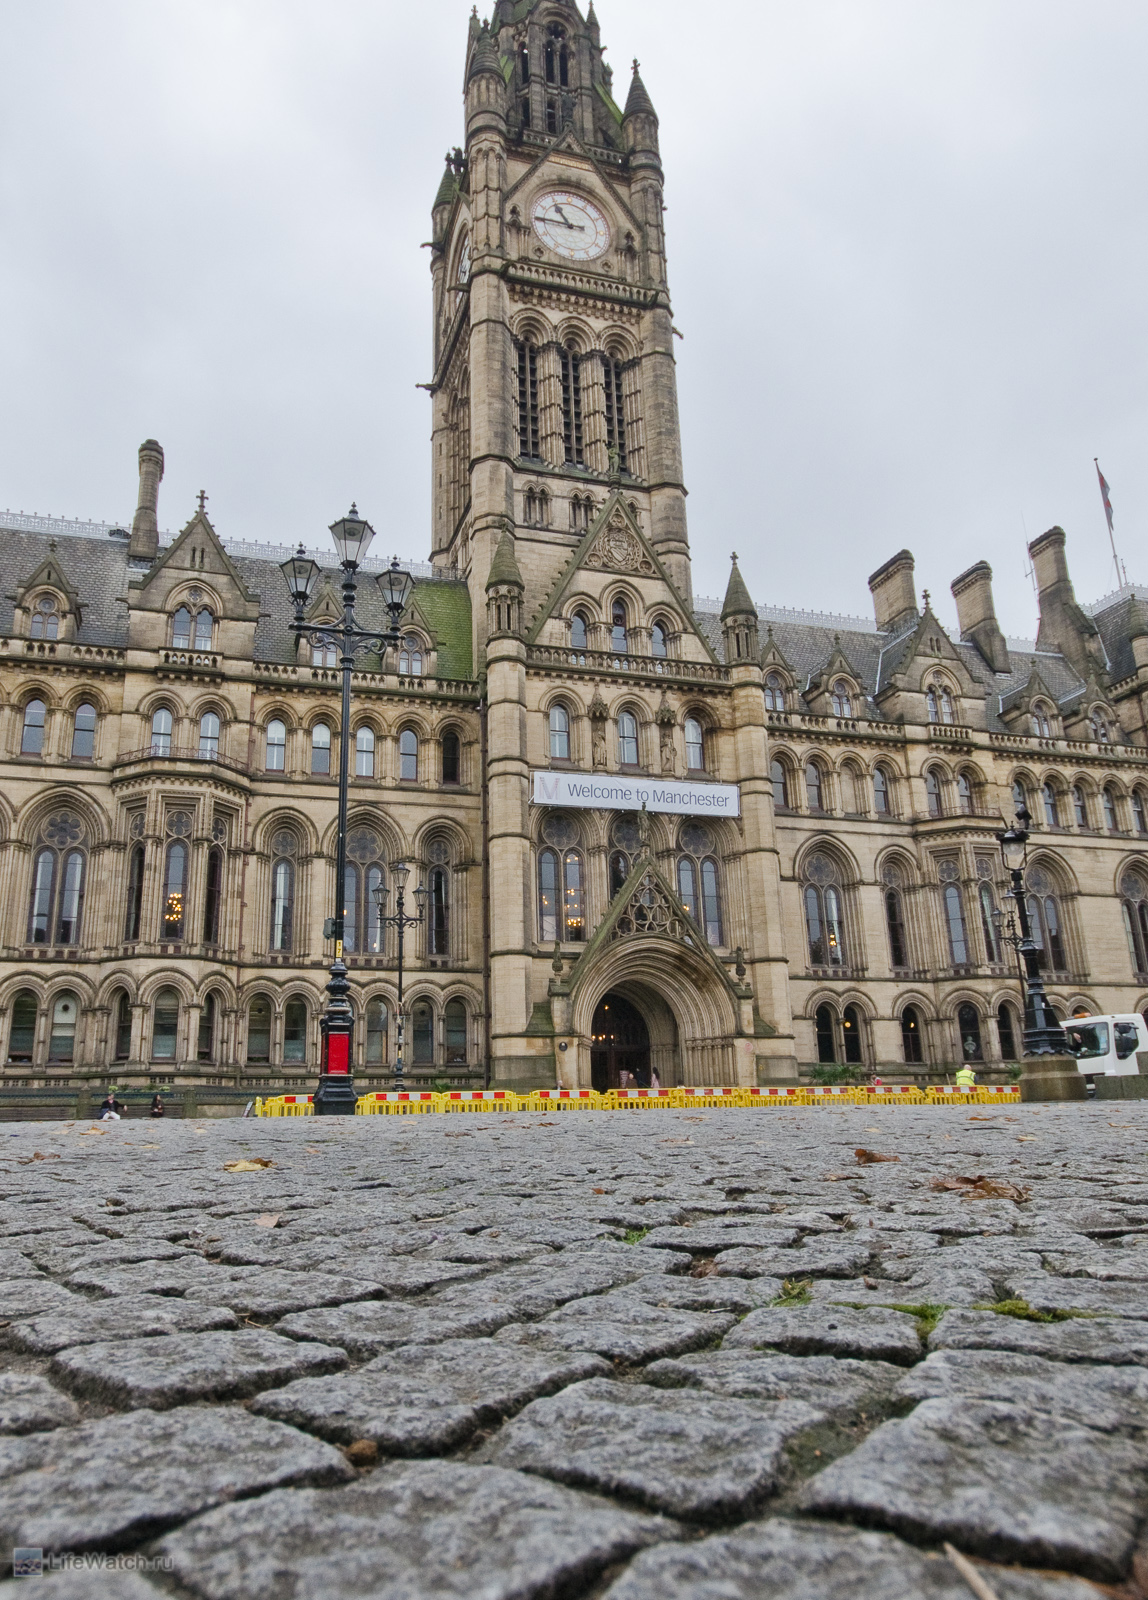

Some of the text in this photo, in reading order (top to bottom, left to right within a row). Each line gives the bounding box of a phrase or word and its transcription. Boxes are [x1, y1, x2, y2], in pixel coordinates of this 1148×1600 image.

[567, 783, 730, 807] Welcome to Manchester
